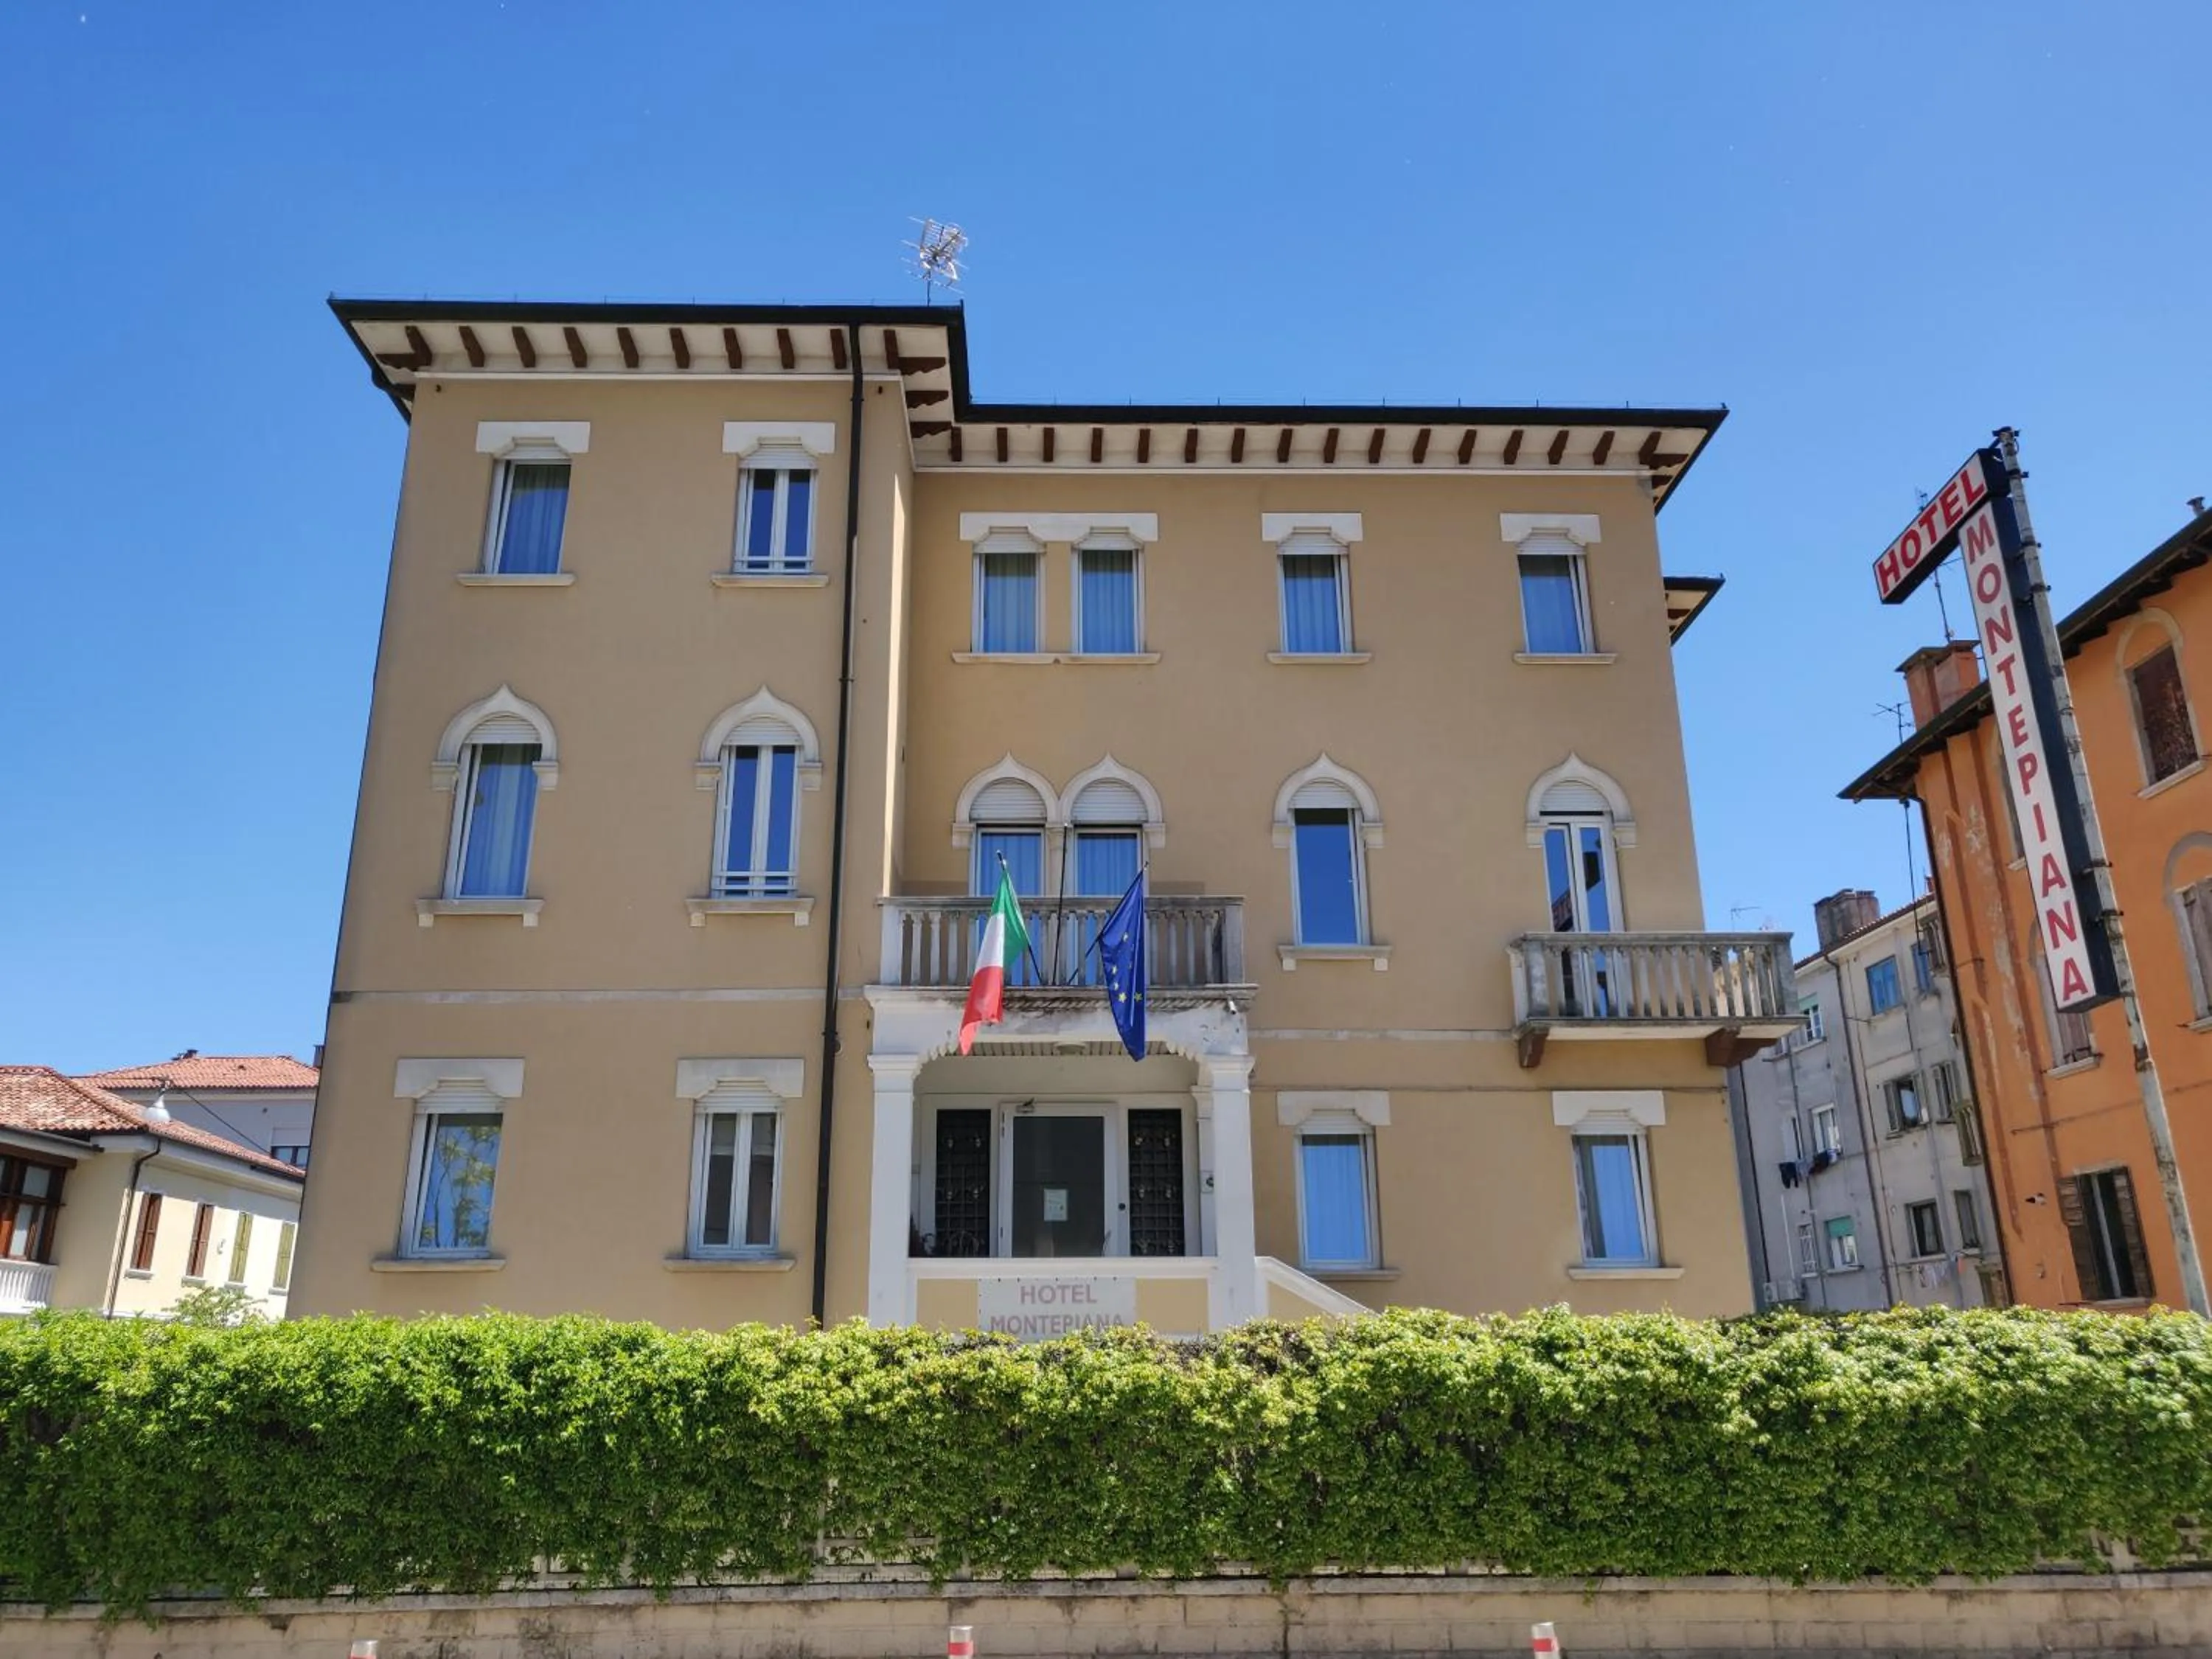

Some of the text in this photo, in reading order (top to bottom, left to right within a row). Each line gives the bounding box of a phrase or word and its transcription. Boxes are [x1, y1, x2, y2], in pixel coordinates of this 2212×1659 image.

[1877, 470, 1985, 595] HOTEL
[1966, 514, 2088, 1001] MONTEPIANA
[1020, 1284, 1097, 1304] HOTEL
